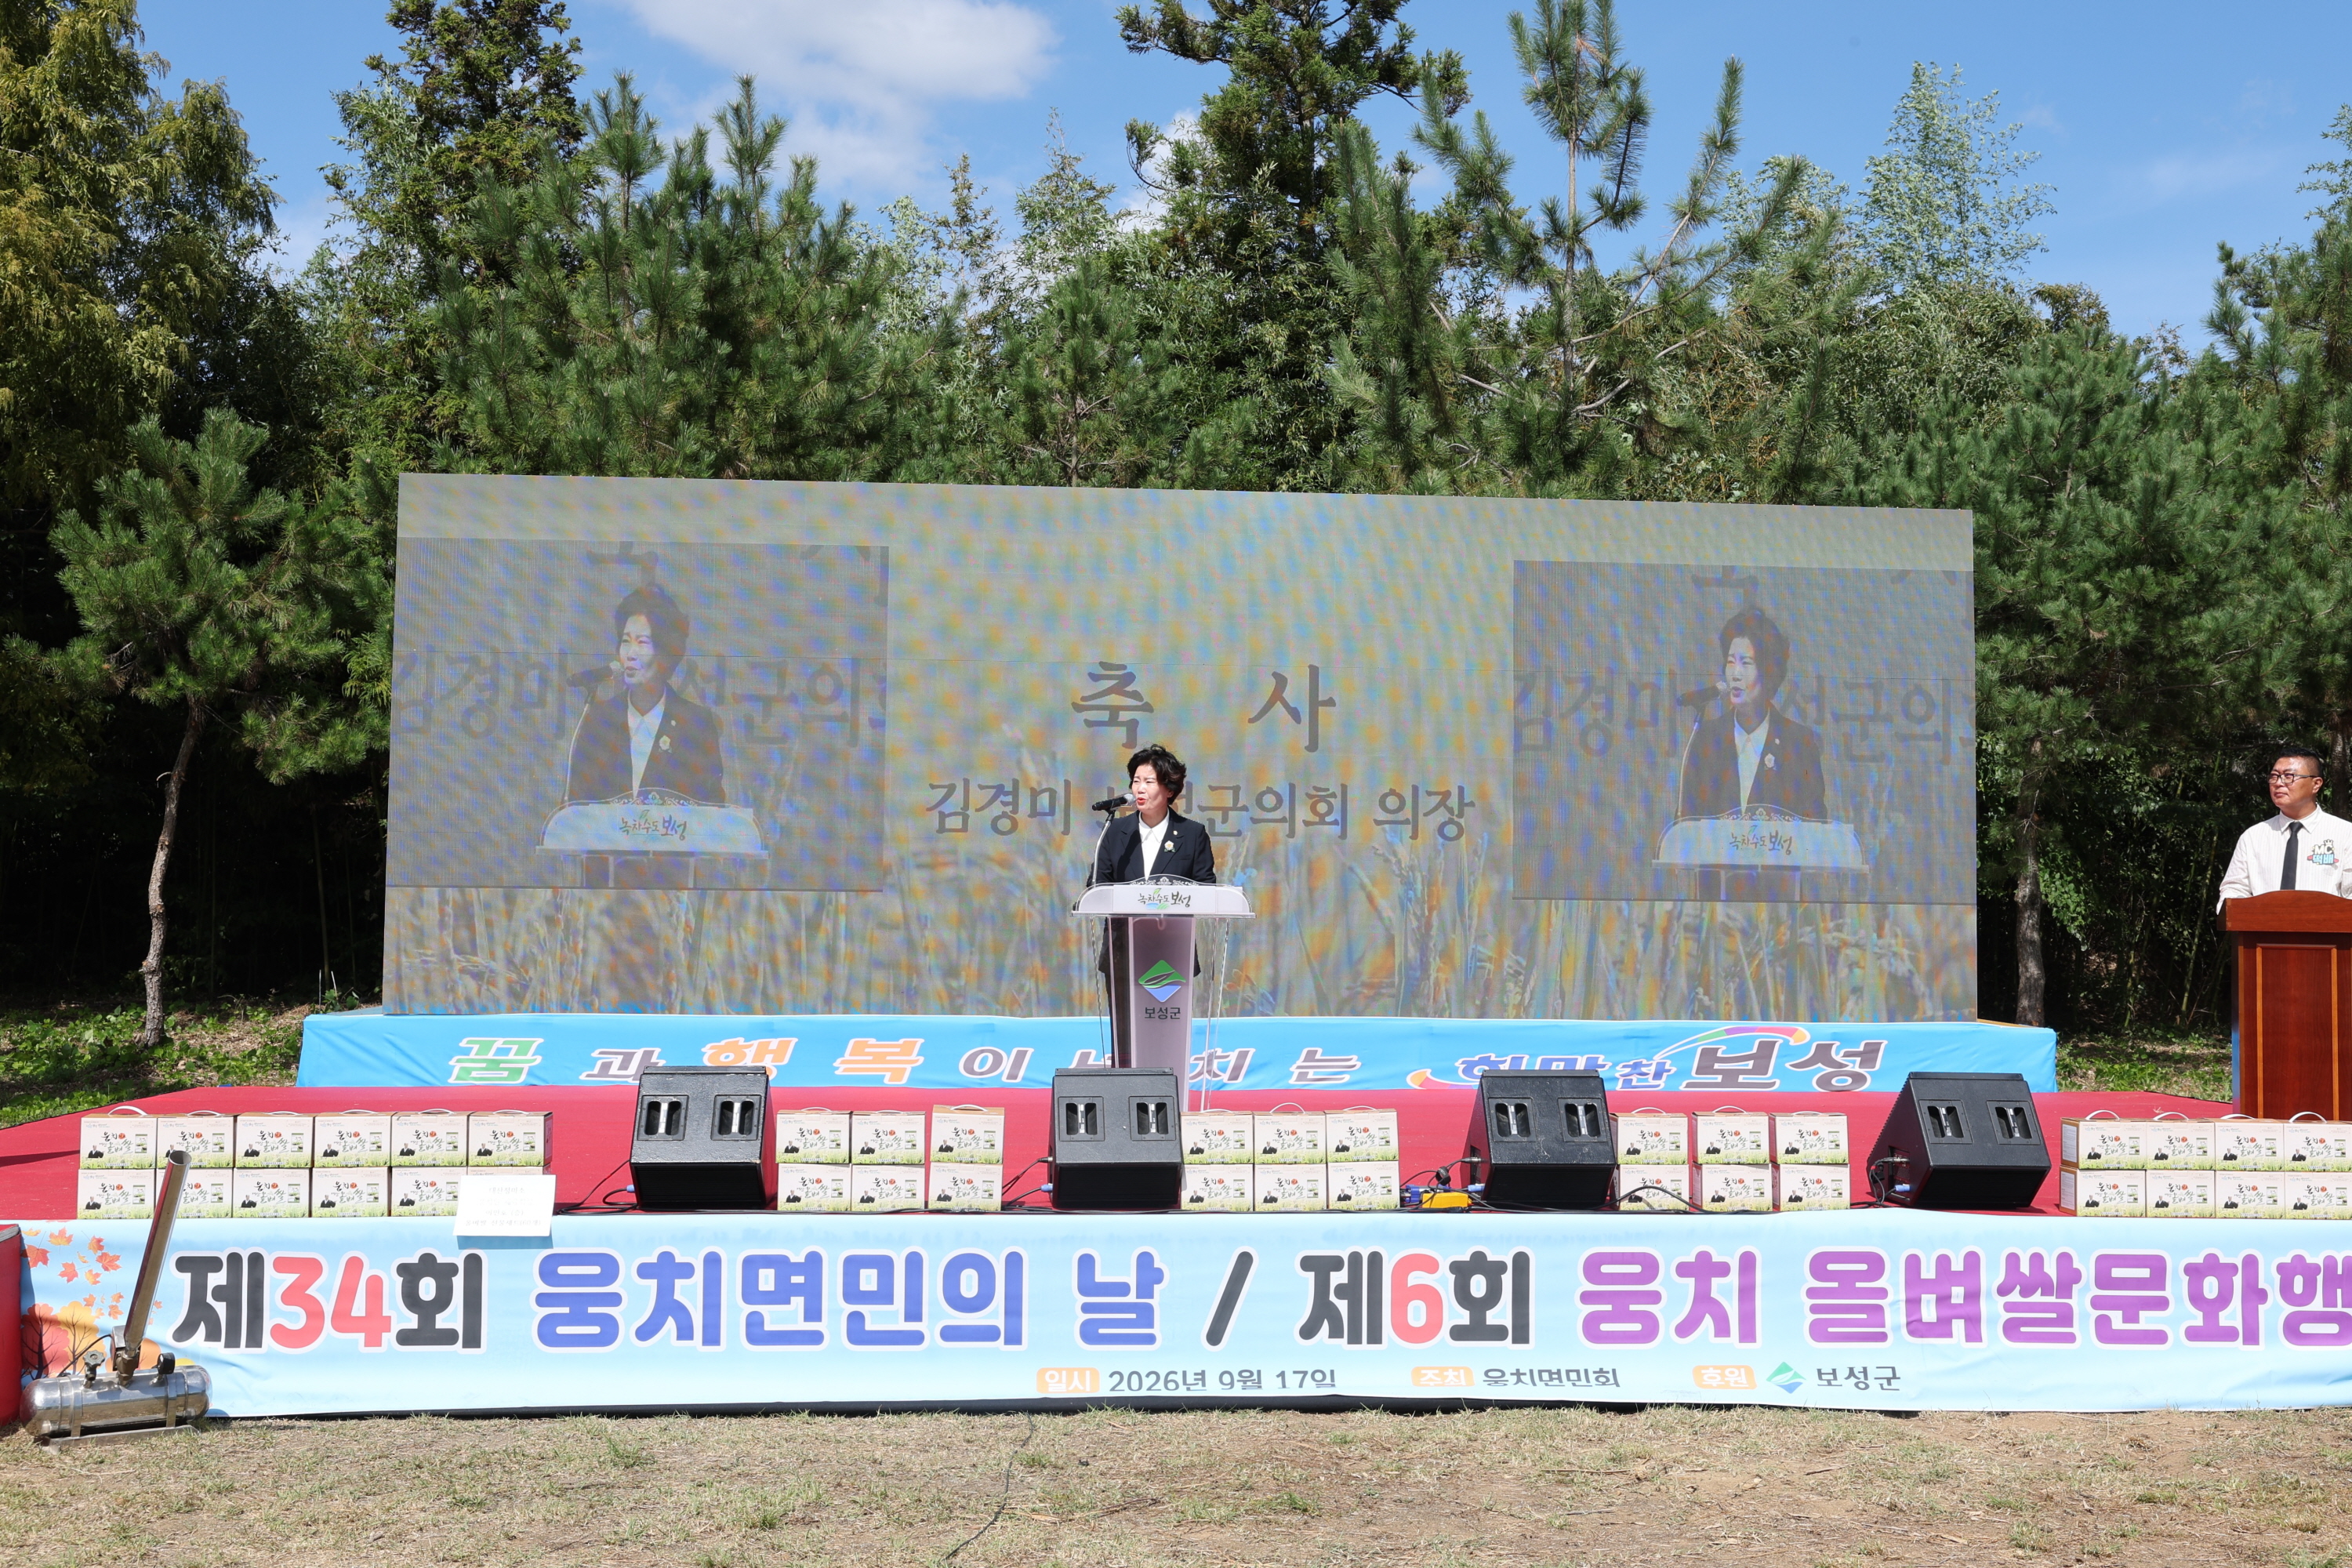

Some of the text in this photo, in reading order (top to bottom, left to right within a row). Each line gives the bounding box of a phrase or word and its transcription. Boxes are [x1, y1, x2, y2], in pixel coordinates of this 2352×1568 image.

[1071, 661, 1337, 753] 축 사
[926, 778, 1475, 842] 김경미 군의회 의장
[619, 815, 687, 840] 녹차수도 보성
[1730, 829, 1792, 855] 녹차수도 보성
[2314, 845, 2333, 854] MC
[1138, 891, 1191, 908] 녹차수도 보성
[1145, 1007, 1181, 1019] 보성군
[1681, 1040, 1886, 1091] 보성
[172, 1252, 482, 1348] 제34회
[535, 1250, 1022, 1348] 웅치면민의
[1076, 1251, 1165, 1346] 날
[1205, 1250, 1254, 1347] /
[1298, 1250, 1530, 1345] 제6회
[1579, 1250, 1757, 1345] 웅치
[1044, 1367, 1901, 1392] 일시 2026년 9월 17일 주최 웅치면민회 후원 보성군
